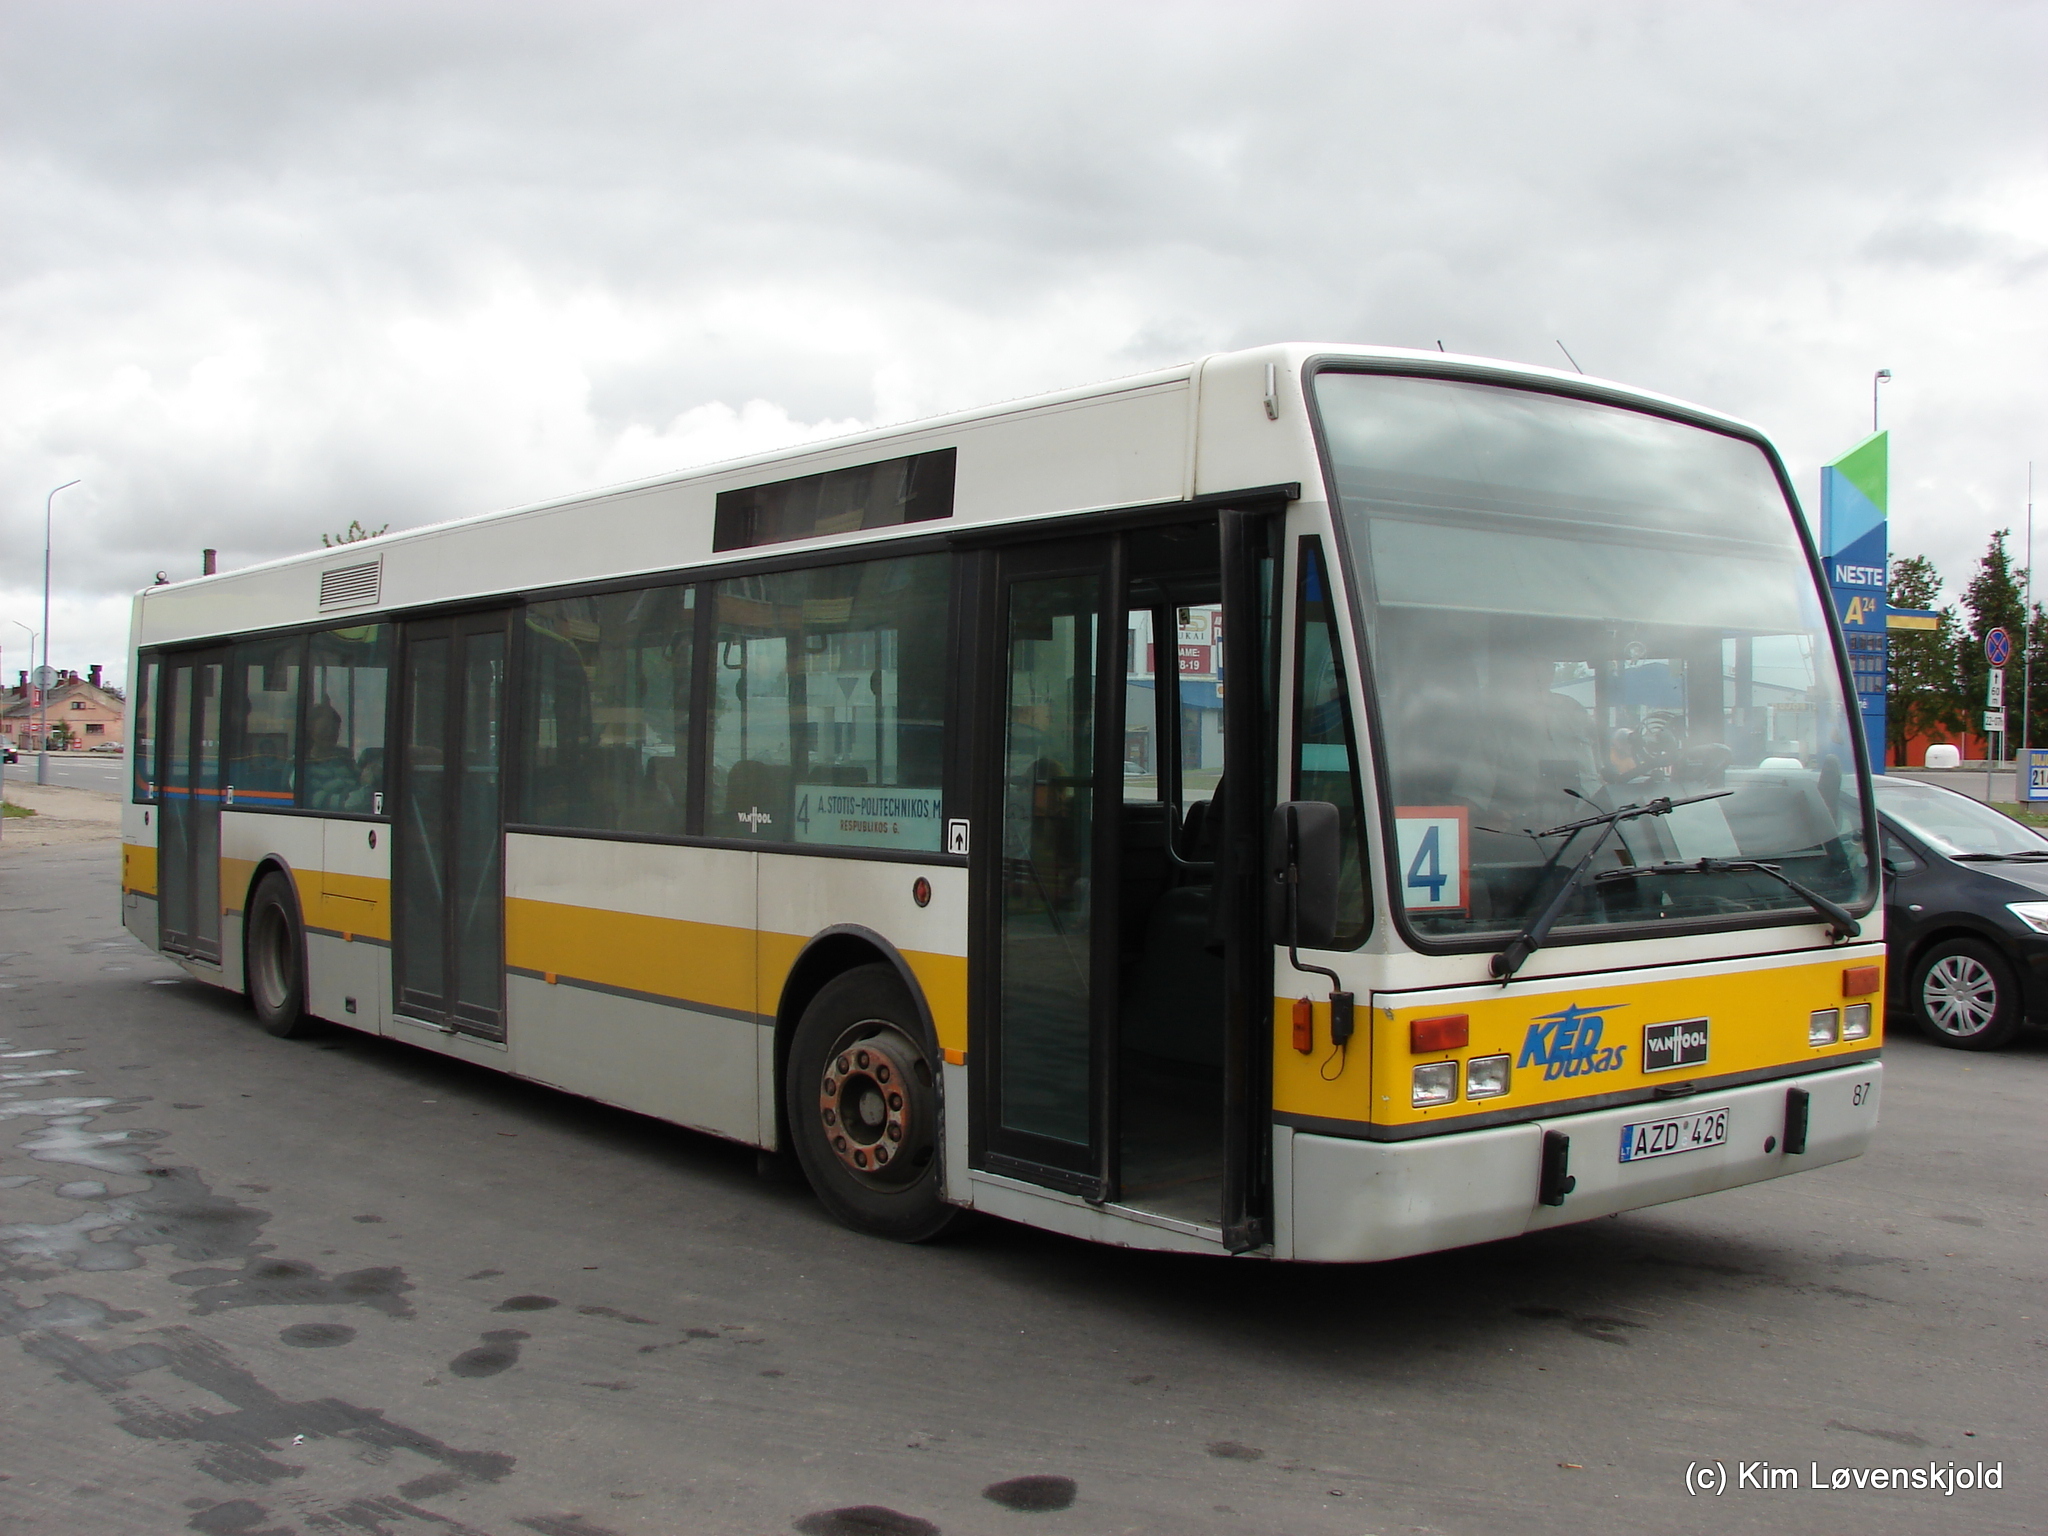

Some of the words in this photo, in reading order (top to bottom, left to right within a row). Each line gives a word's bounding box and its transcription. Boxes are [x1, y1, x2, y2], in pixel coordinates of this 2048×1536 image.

[1835, 564, 1884, 587] NESTE
[2032, 769, 2048, 786] 21
[796, 793, 810, 834] 4
[840, 819, 888, 833] RESPUBLIKOS
[1407, 825, 1448, 902] 4
[1543, 1045, 1628, 1081] busas
[1852, 1081, 1871, 1106] 87
[1634, 1122, 1679, 1156] AZD
[1691, 1113, 1726, 1145] 426
